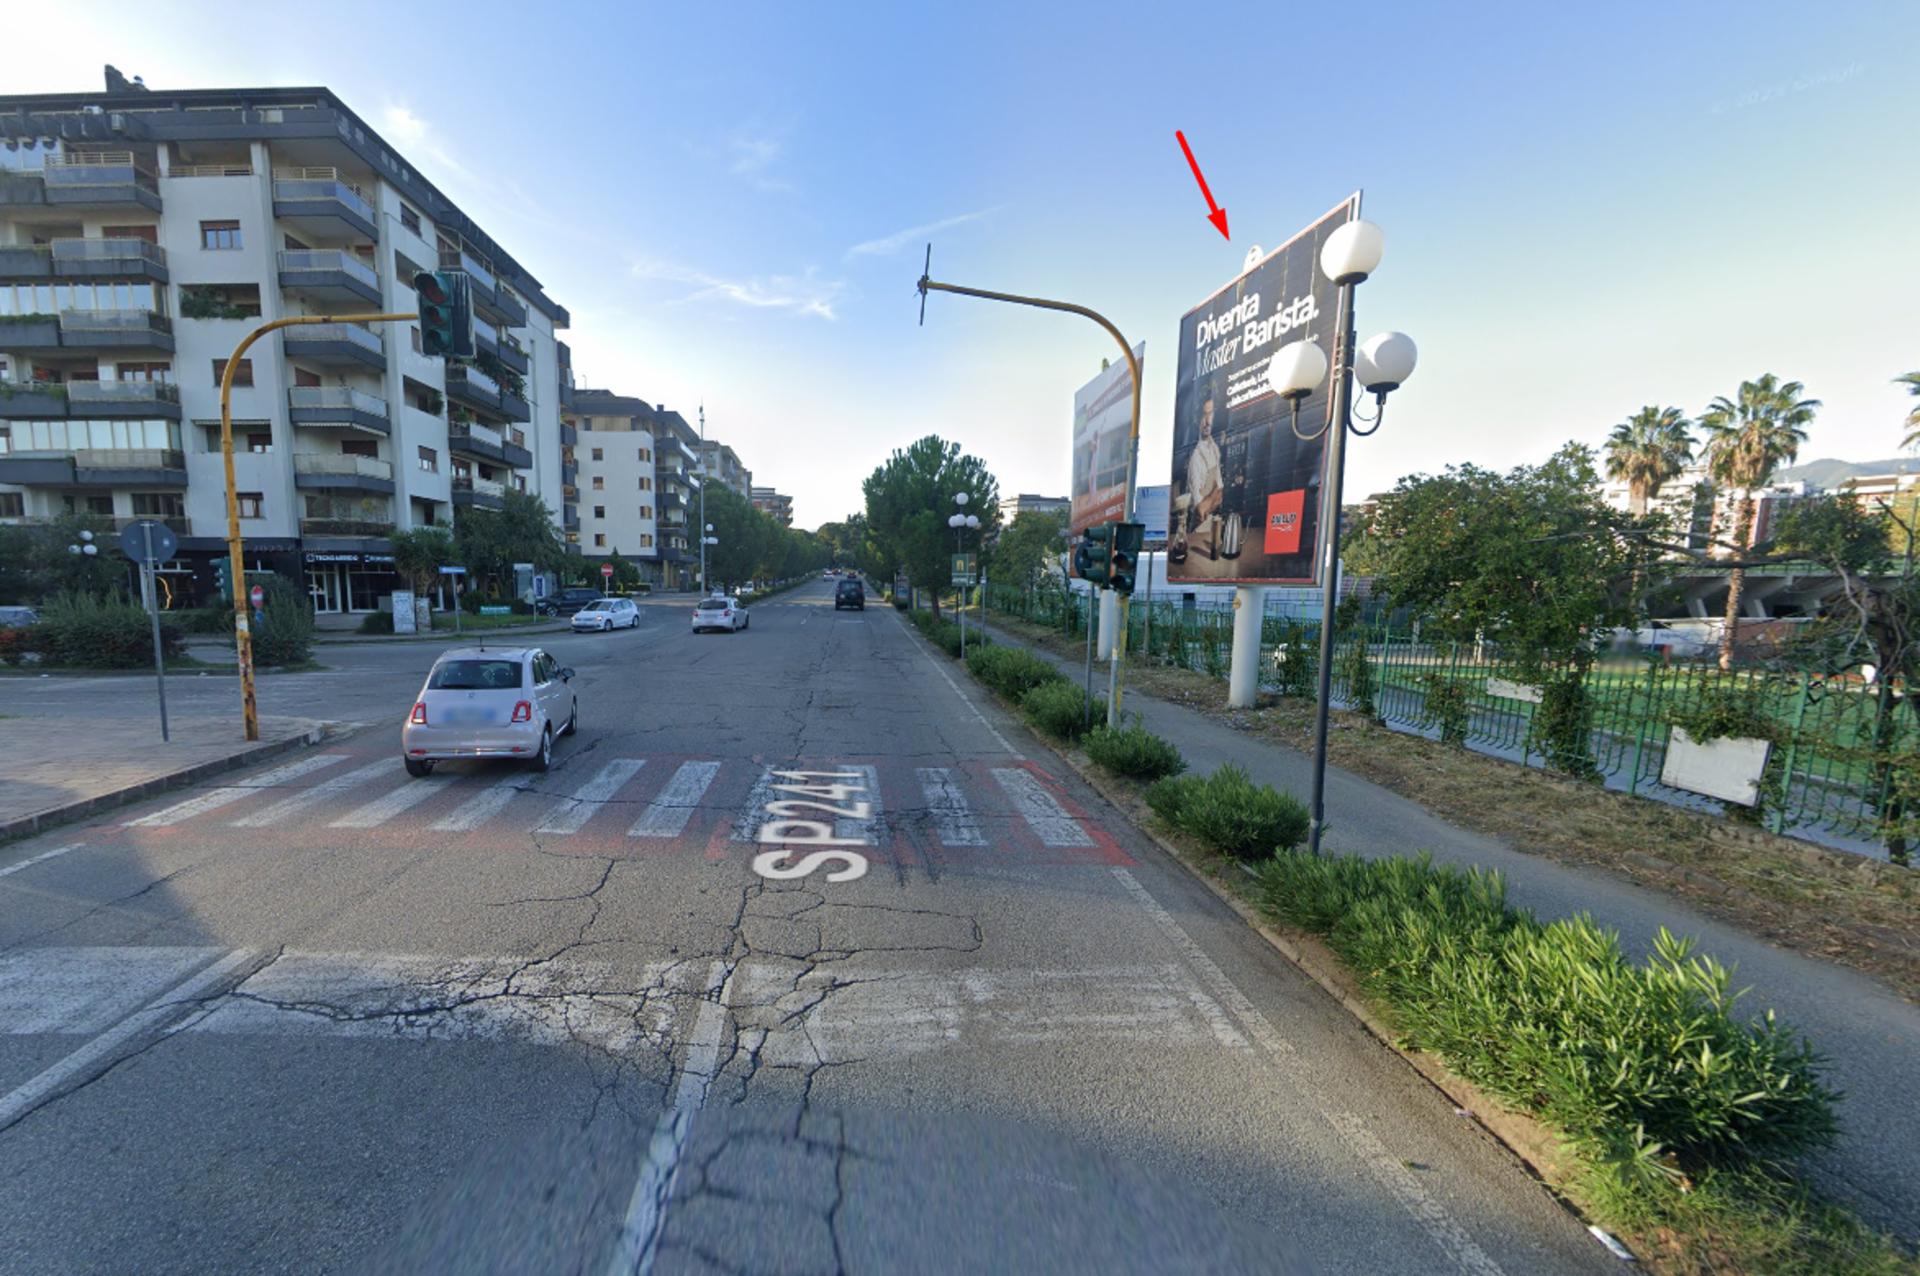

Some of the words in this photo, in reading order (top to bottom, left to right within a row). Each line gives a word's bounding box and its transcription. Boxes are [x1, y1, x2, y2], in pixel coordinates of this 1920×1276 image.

[1192, 336, 1242, 384] Master
[1243, 295, 1319, 354] Barista.
[1196, 293, 1259, 349] Diventa
[753, 770, 870, 883] SP241
